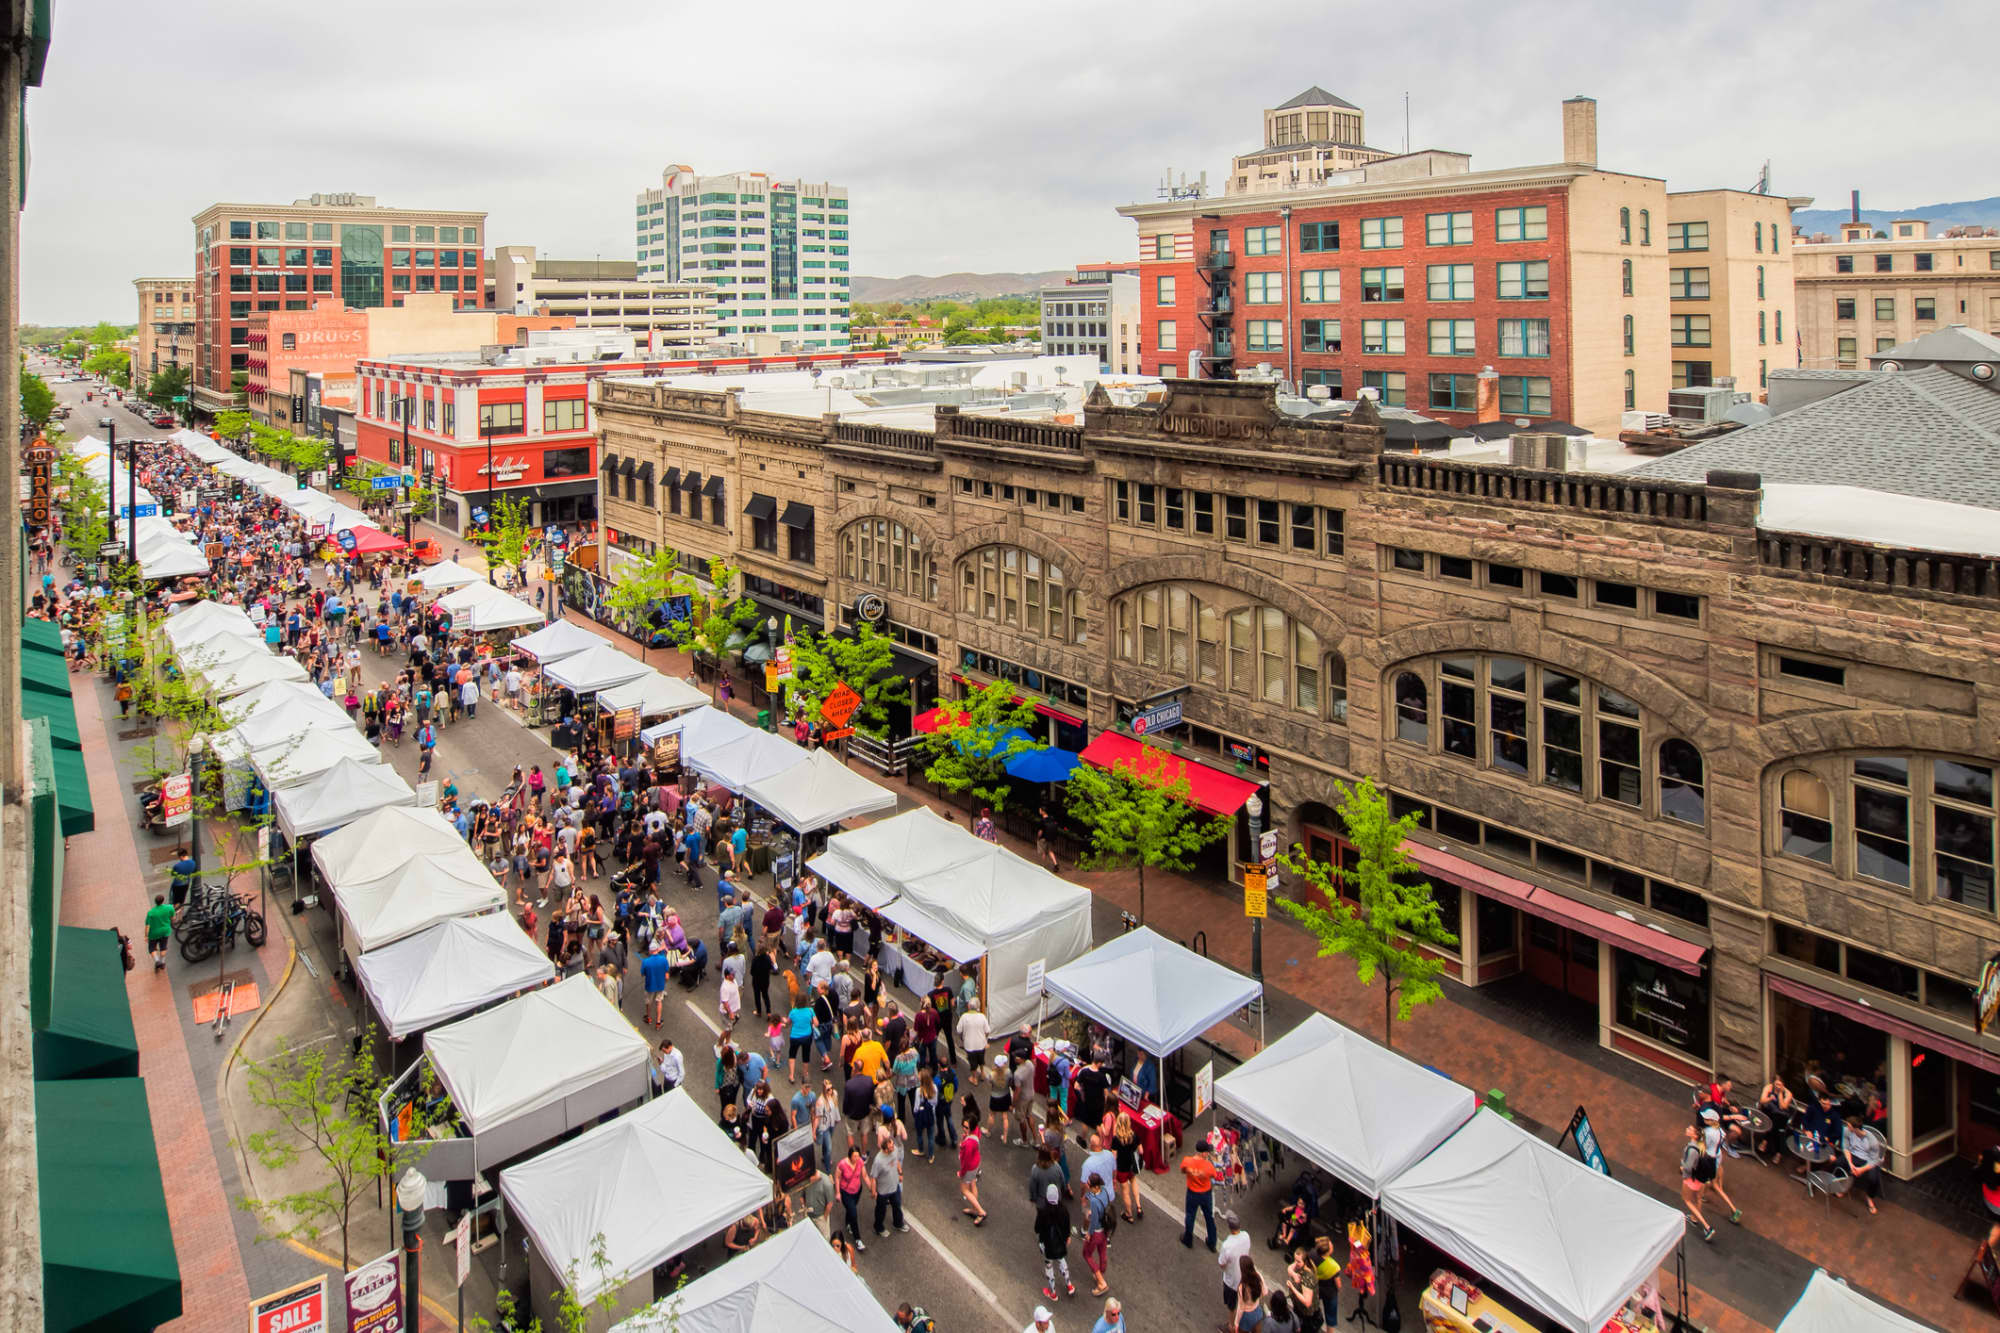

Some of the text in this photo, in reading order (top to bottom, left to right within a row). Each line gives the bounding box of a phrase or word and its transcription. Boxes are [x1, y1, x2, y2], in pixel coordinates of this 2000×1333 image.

[298, 330, 362, 343] DRUGS
[1163, 413, 1272, 439] UNION BLOCK
[33, 465, 47, 520] IDAHO
[829, 698, 853, 709] CLOSED
[833, 690, 850, 698] ROAD
[832, 707, 852, 717] AHEAD
[1145, 714, 1156, 727] OLD
[1156, 706, 1180, 723] CHICAGO
[351, 1273, 396, 1299] MARKET
[270, 1303, 311, 1333] SALE
